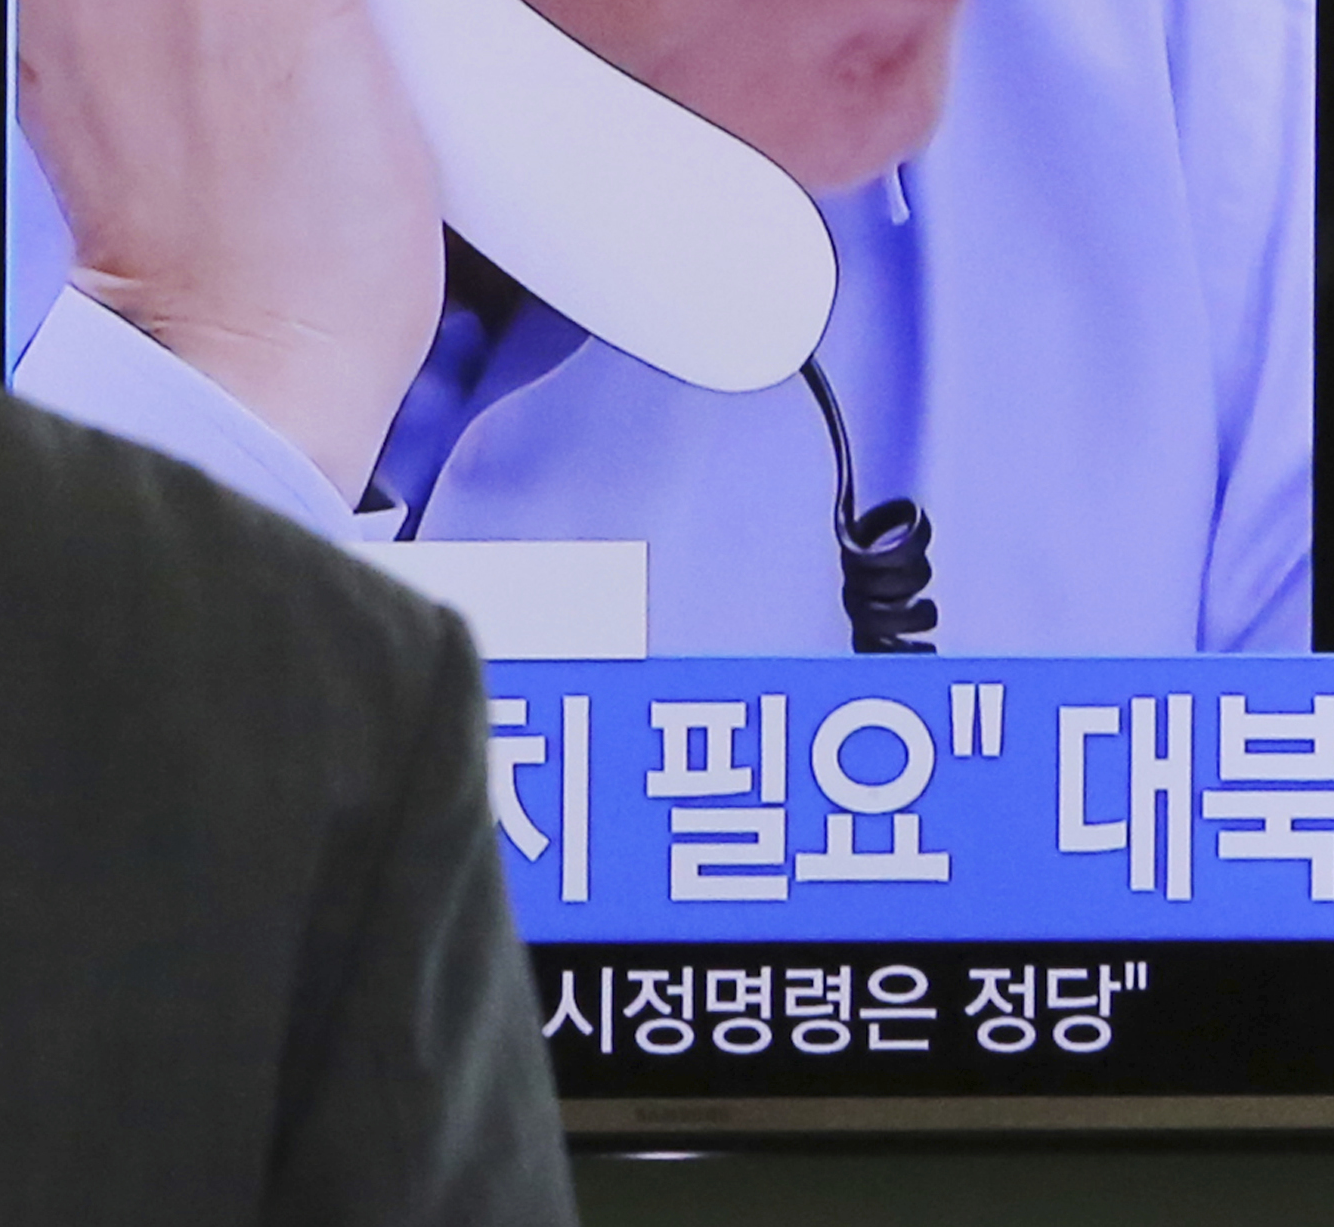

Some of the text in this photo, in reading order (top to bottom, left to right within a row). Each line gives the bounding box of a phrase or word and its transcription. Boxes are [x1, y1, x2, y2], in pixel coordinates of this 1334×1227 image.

[645, 682, 1006, 903] 필요"
[541, 961, 1149, 1055] 시정명령은 정당"
